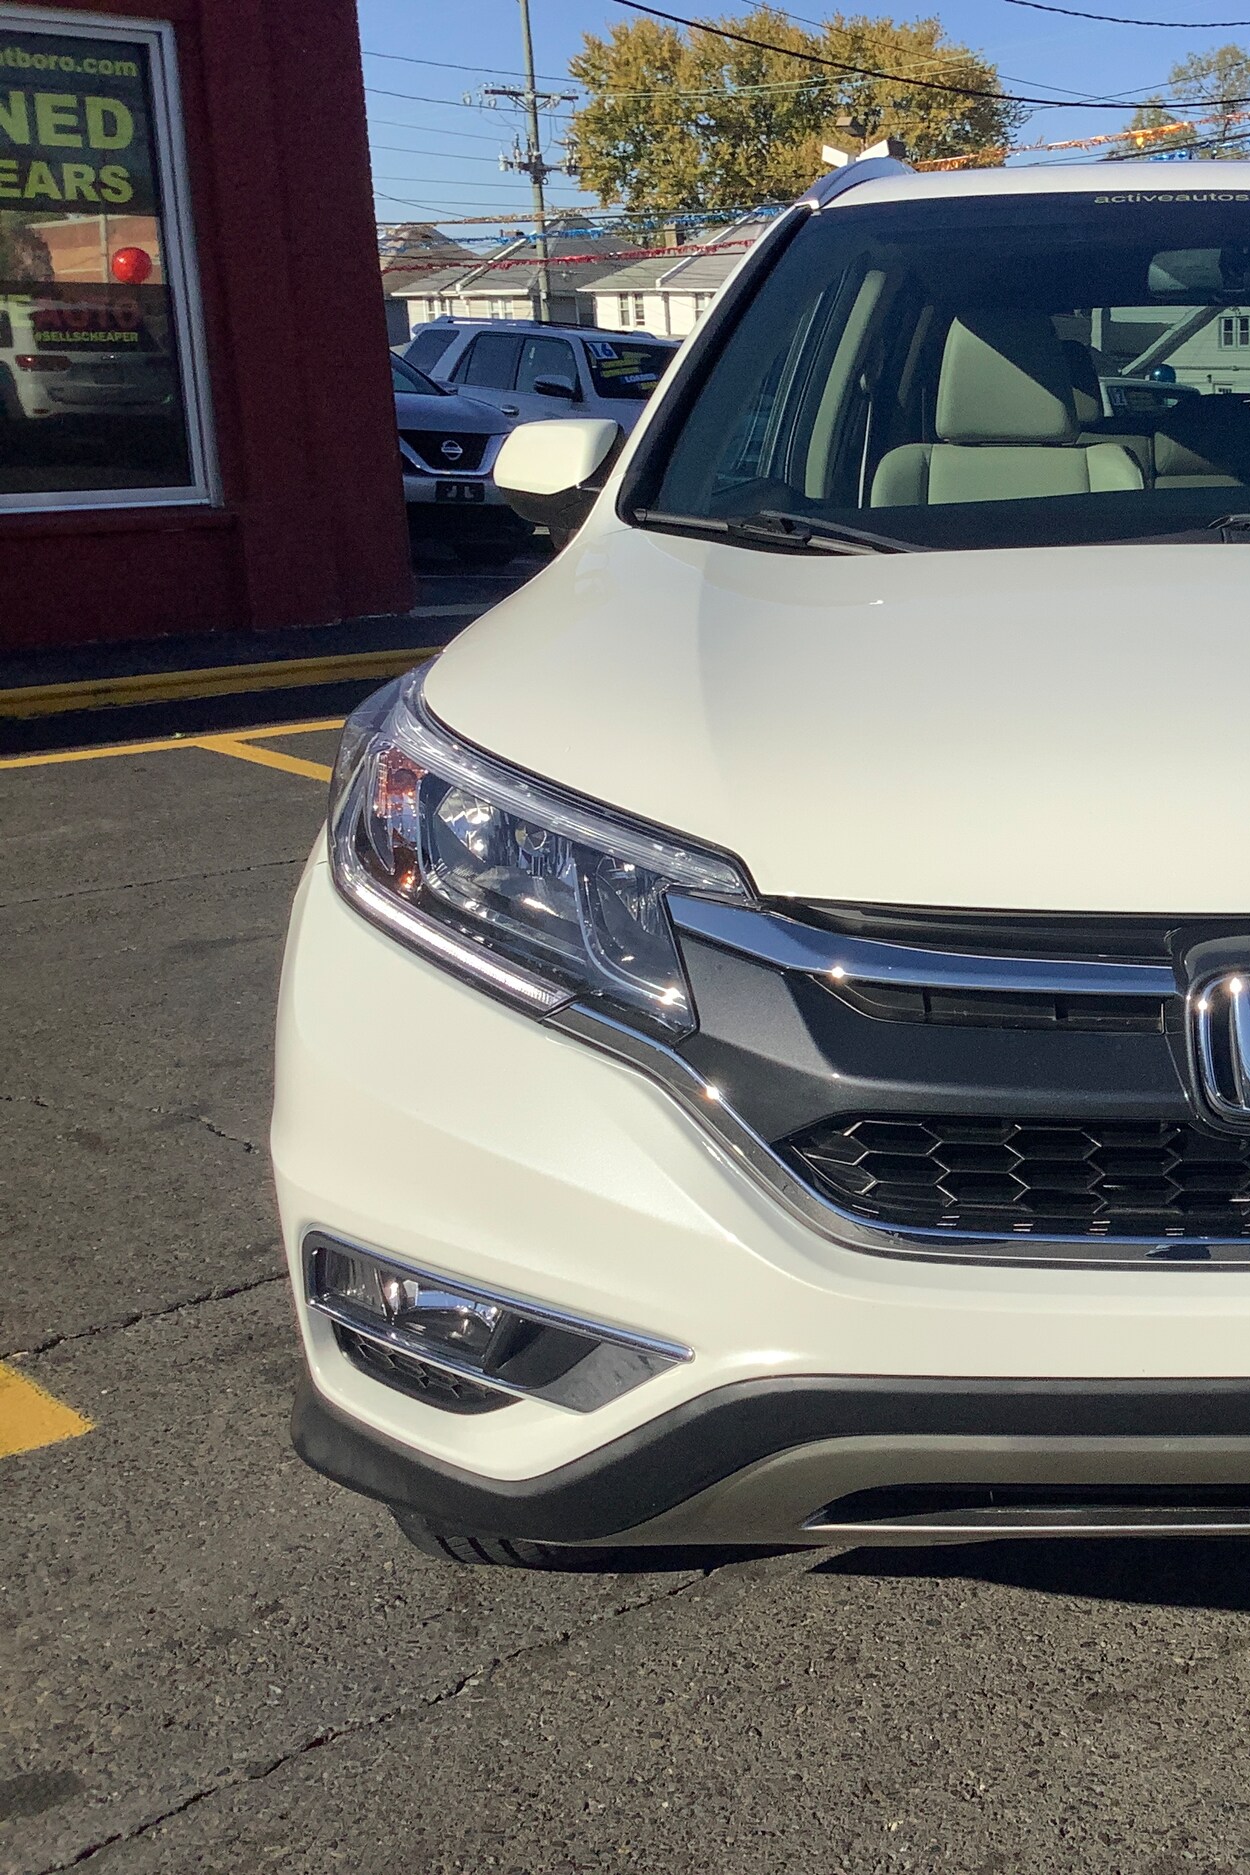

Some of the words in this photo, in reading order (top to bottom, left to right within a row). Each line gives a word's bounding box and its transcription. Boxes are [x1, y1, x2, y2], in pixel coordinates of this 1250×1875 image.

[0, 47, 139, 77] tboro.com
[0, 159, 133, 203] EARS
[589, 343, 614, 357] 16
